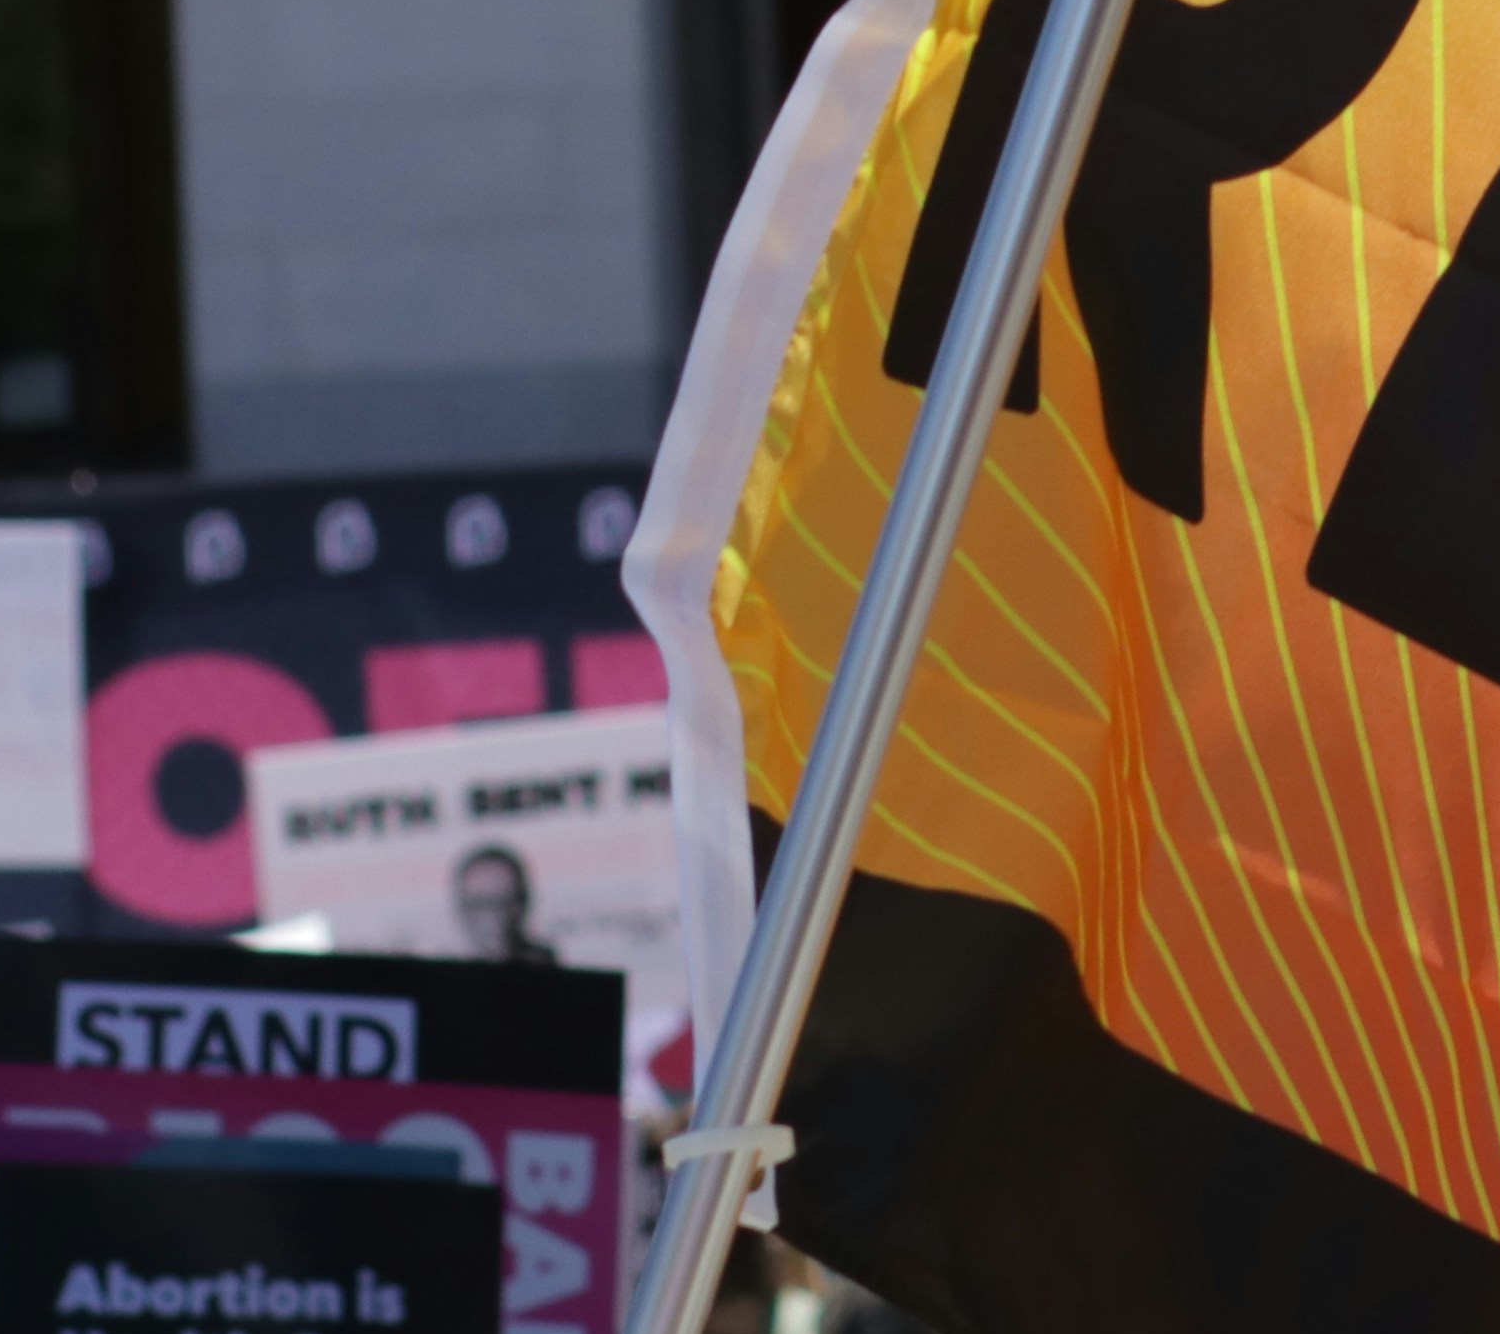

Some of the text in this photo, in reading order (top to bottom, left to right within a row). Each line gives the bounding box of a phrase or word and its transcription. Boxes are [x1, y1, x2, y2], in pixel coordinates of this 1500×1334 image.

[285, 791, 439, 843] RUTH
[466, 771, 600, 821] SENT
[76, 1000, 400, 1081] STAND
[57, 1261, 407, 1326] Abortion is
